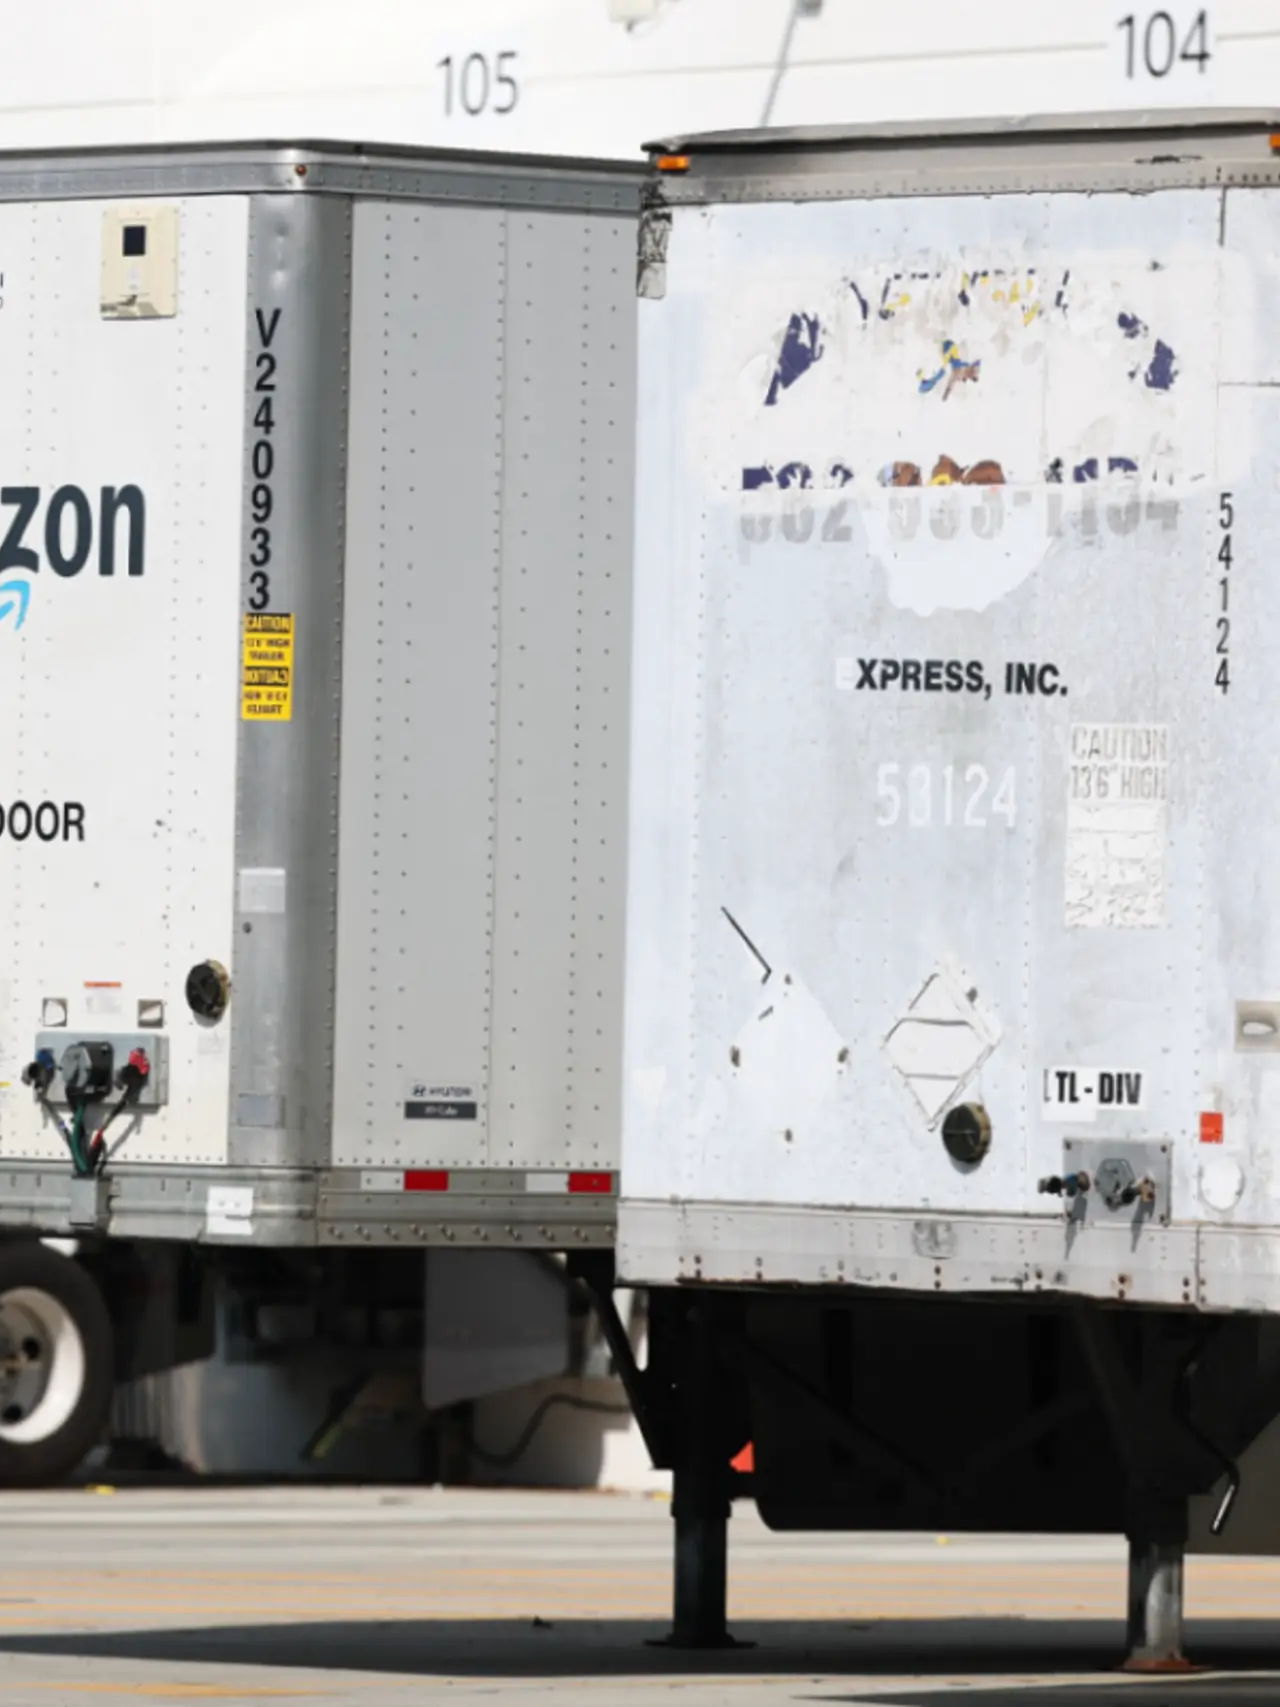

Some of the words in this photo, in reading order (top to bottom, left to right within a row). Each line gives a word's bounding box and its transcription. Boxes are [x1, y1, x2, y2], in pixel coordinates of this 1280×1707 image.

[1117, 9, 1212, 79] 104
[438, 50, 518, 117] 105
[248, 307, 282, 611] V240933
[1214, 492, 1235, 695] 54124
[856, 658, 992, 701] XPRESS,
[1005, 662, 1068, 696] INC.
[1071, 726, 1167, 761] CAUTION
[1121, 765, 1166, 800] HIGH
